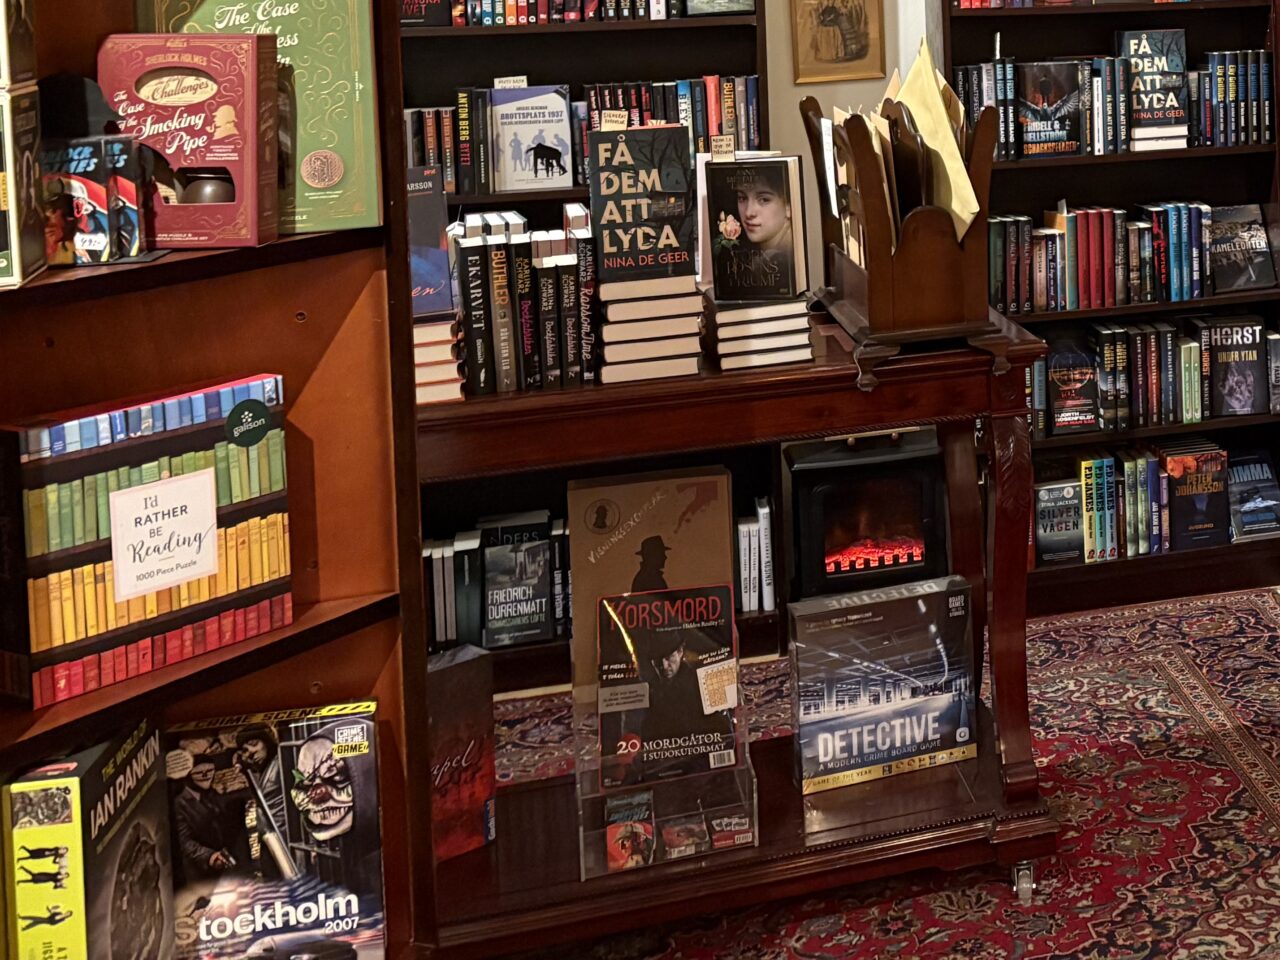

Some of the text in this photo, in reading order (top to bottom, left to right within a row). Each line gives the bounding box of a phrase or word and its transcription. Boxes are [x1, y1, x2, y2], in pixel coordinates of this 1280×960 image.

[214, 5, 250, 30] The
[1129, 33, 1152, 55] FÅ
[182, 54, 208, 67] HOLMES
[1131, 56, 1169, 73] DEM
[149, 78, 210, 103] Challenges
[1132, 75, 1163, 91] ATT
[113, 90, 129, 103] The
[1132, 92, 1179, 110] LYDA
[118, 101, 145, 116] Case
[458, 93, 470, 141] ANTON BERG
[500, 111, 547, 121] BROTTSPLATS
[1133, 109, 1185, 120] NINA DE GEER
[133, 111, 206, 142] Smoking
[166, 130, 208, 156] Pipe
[598, 133, 635, 168] FÅ
[600, 169, 663, 196] DEM
[600, 198, 652, 225] ATT
[603, 225, 679, 254] LYDA
[1211, 239, 1267, 254] KAMELEONTEN
[578, 241, 587, 283] SCHWARZ
[604, 251, 689, 269] NINA DE GEER
[491, 250, 509, 305] BUTHLER
[467, 255, 485, 330] EKARVET
[1211, 325, 1262, 346] HORST
[233, 416, 266, 437] galison
[1228, 463, 1273, 484] DIMMA
[143, 496, 159, 511] I'd
[1040, 506, 1080, 521] SILVER
[134, 504, 189, 528] RATHER
[1041, 518, 1080, 534] VÄGEN
[127, 523, 216, 563] Reading
[149, 526, 164, 539] BE
[136, 559, 198, 582] 1000 Piece Puzzle
[488, 585, 533, 605] FRIEDRICH
[488, 598, 547, 620] DÜRRENMATT
[610, 595, 722, 632] KORSMORD
[337, 725, 366, 739] CRIME
[818, 712, 941, 763] DETECTIVE
[338, 743, 365, 756] GAME
[616, 732, 722, 756] 20 MORDGÅTOR
[649, 742, 726, 761] SUDOKUFORMAT
[827, 739, 942, 770] MODERN CRIME BOARD GAME
[90, 728, 160, 840] IAN RANKIN
[175, 893, 359, 944] Stockholm
[325, 916, 360, 935] 2007
